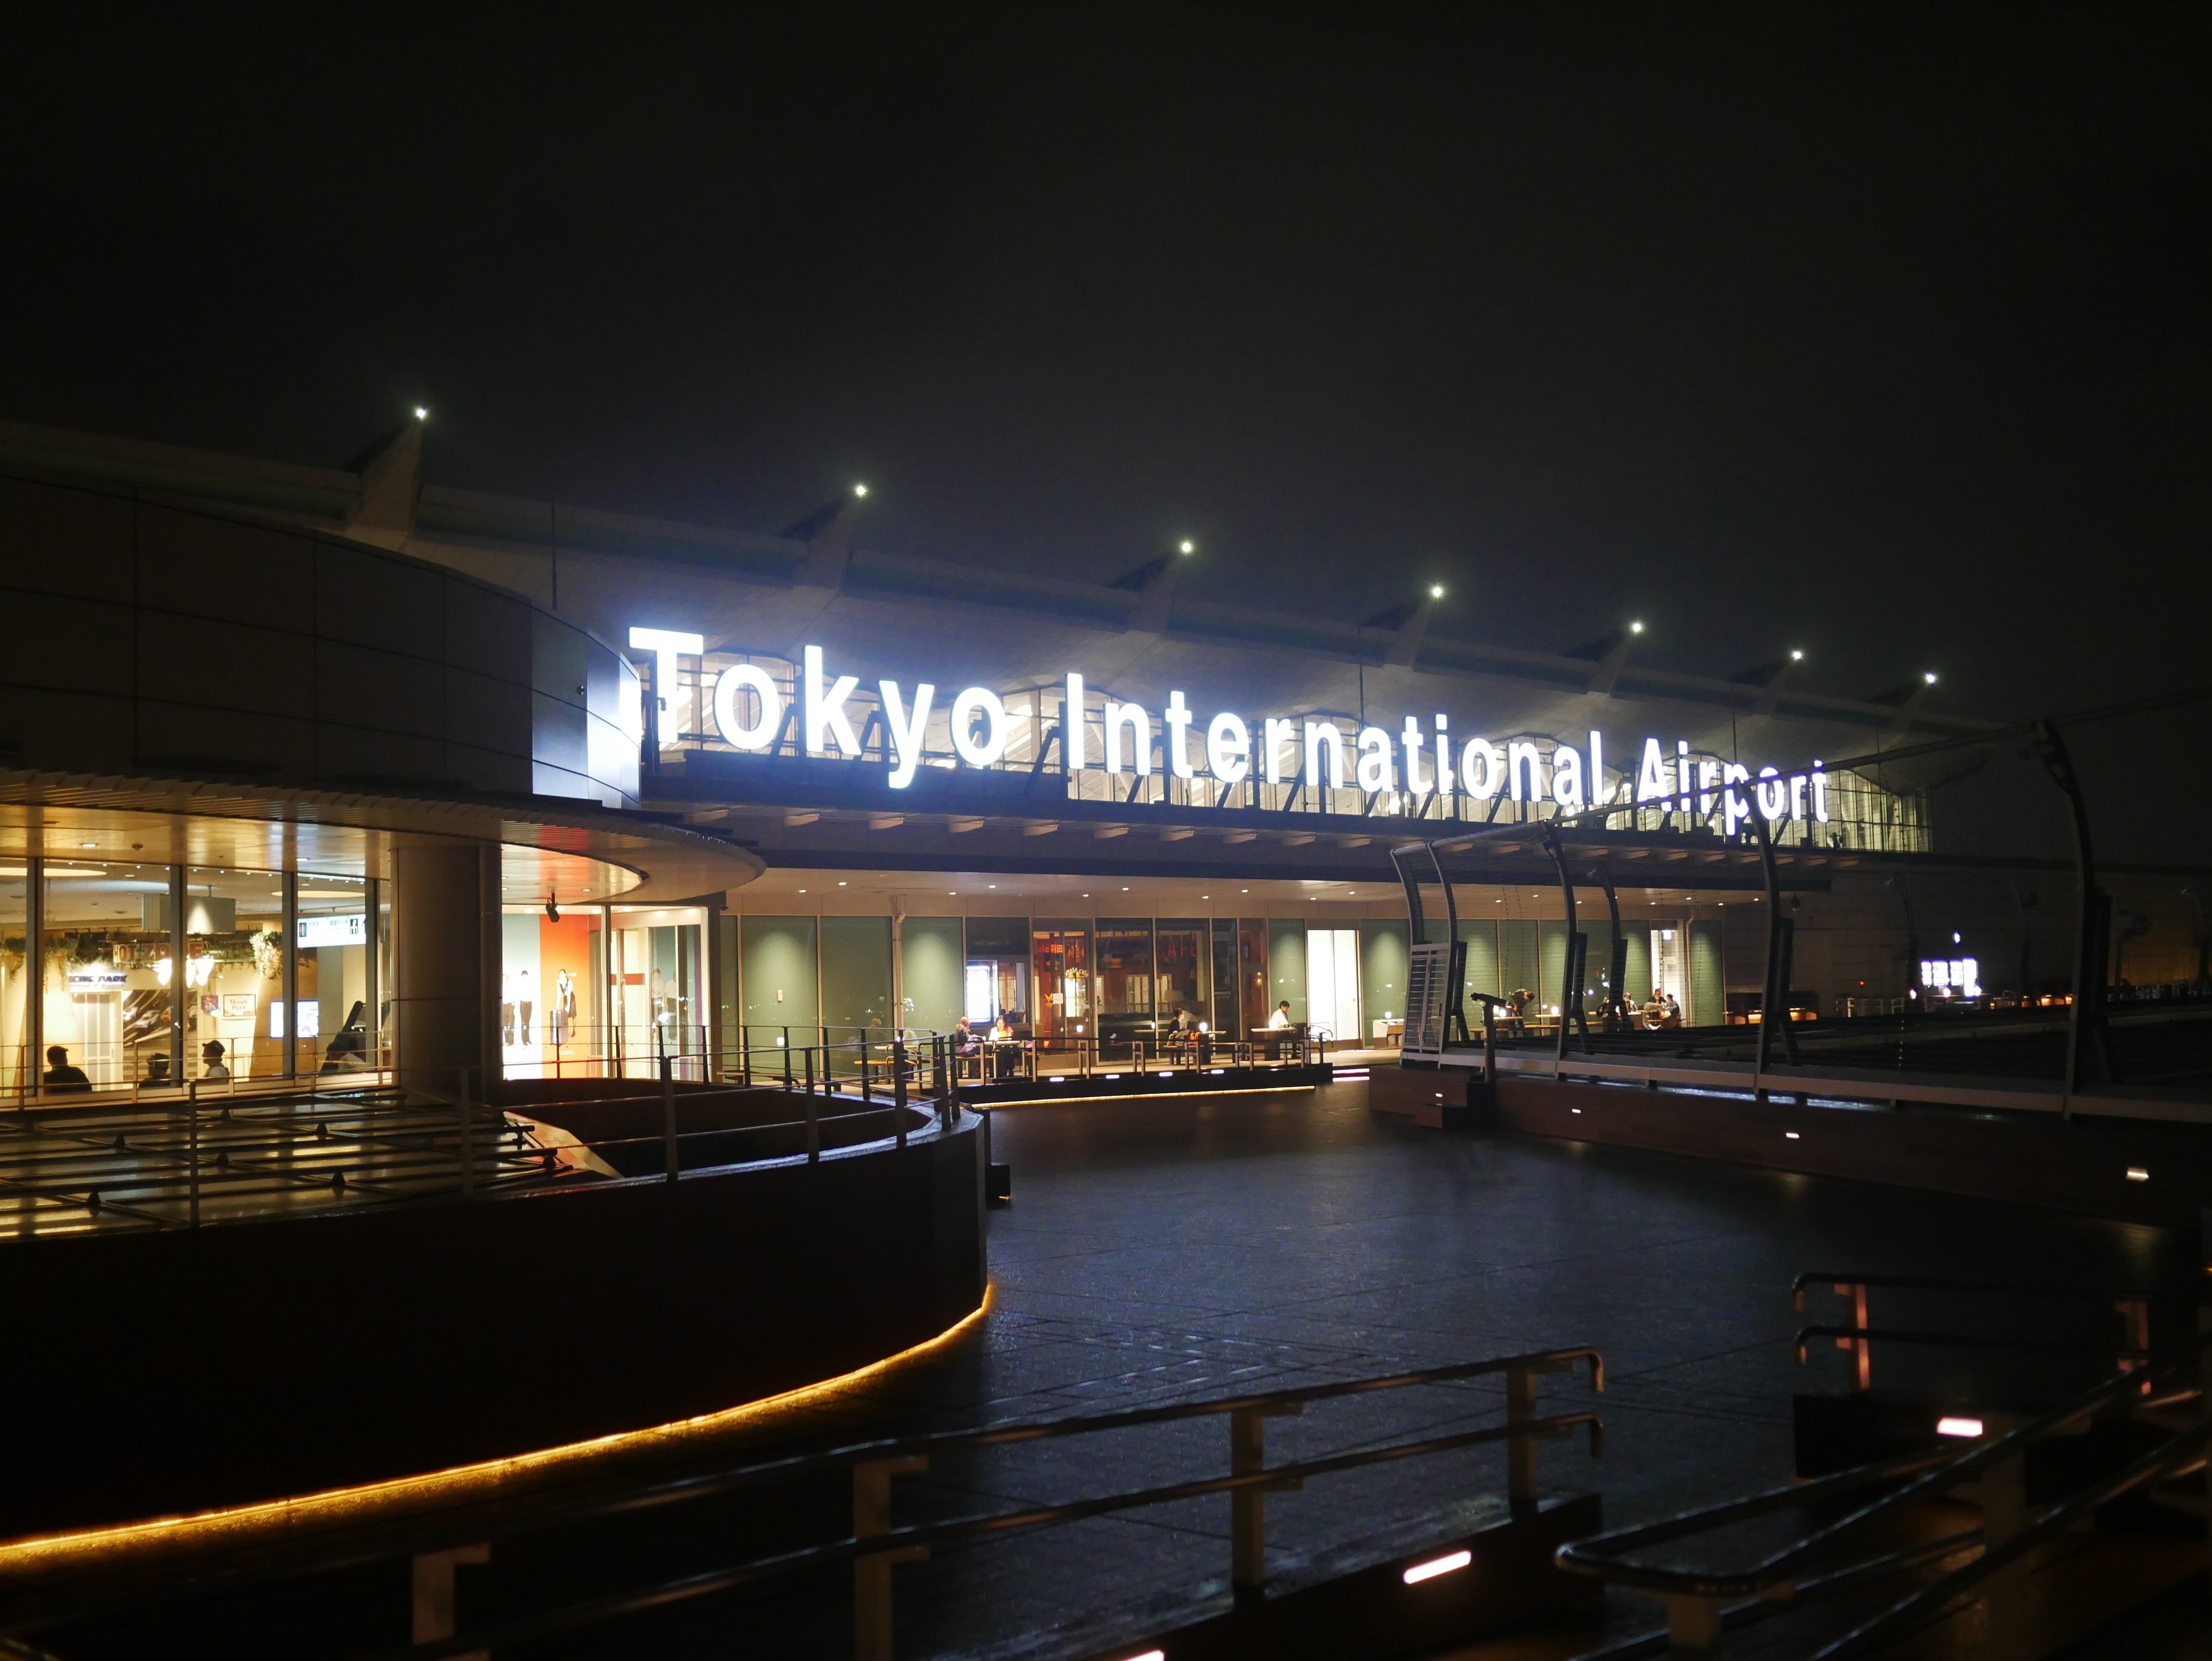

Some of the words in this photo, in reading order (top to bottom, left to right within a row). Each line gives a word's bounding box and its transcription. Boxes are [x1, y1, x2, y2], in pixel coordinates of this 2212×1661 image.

[629, 627, 1006, 788] Tokyo
[1066, 672, 1604, 806] International
[1637, 738, 1829, 836] Airport
